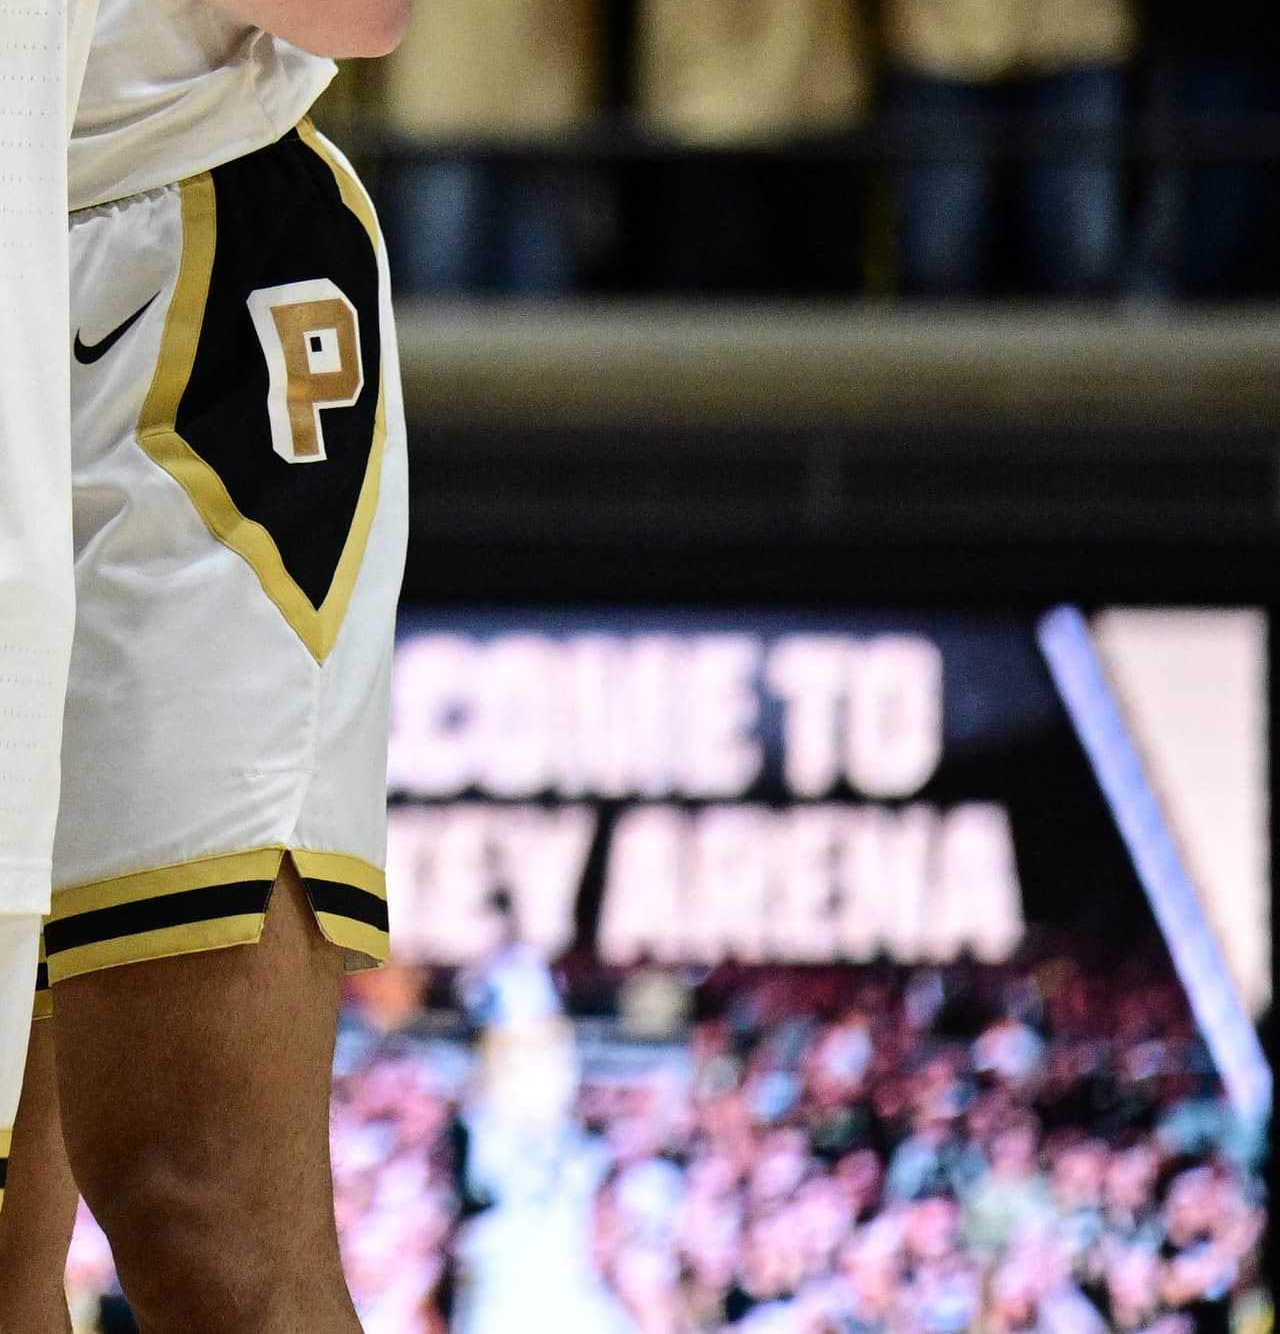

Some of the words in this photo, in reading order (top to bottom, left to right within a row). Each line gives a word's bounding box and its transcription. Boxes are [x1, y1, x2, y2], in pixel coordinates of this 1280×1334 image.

[246, 278, 364, 464] P
[388, 634, 758, 794] COME
[768, 636, 938, 794] TO
